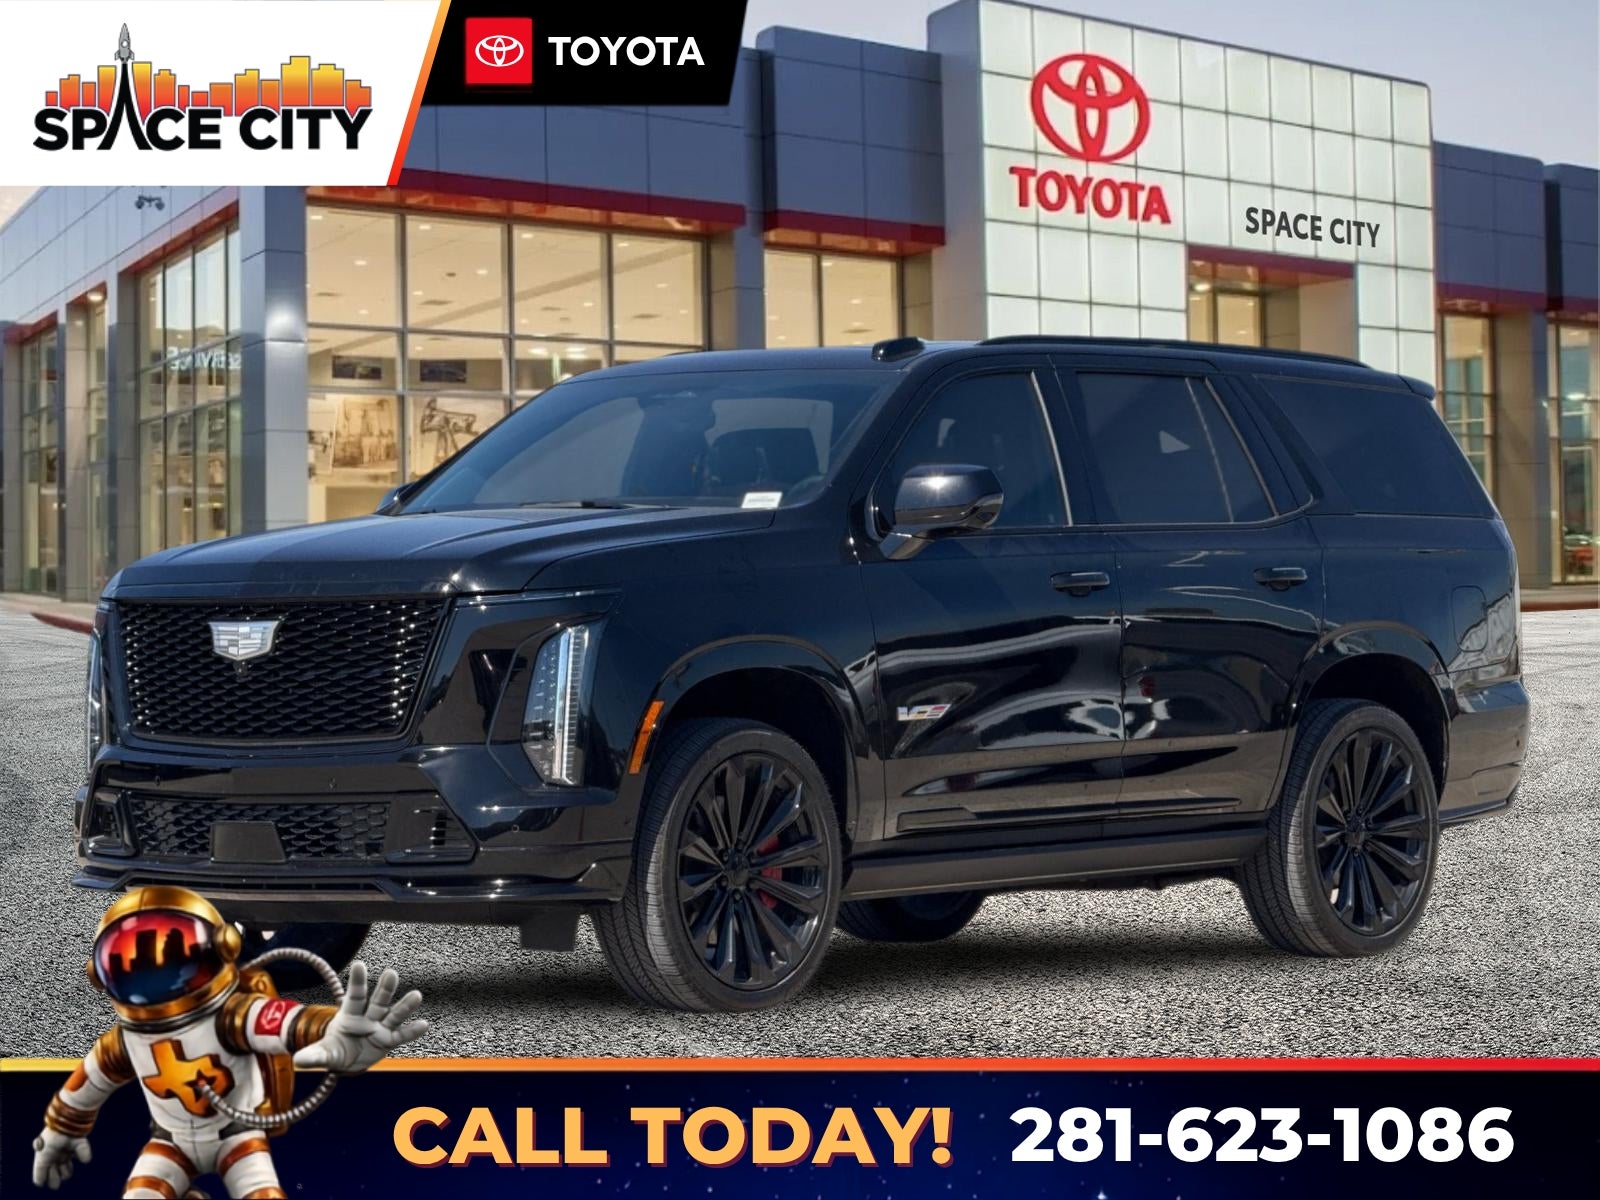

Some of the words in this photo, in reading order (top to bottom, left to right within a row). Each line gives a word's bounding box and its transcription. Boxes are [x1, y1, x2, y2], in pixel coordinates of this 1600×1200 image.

[1009, 166, 1171, 224] TOYOTA
[1245, 206, 1323, 242] SPACE
[1329, 217, 1381, 248] CITY
